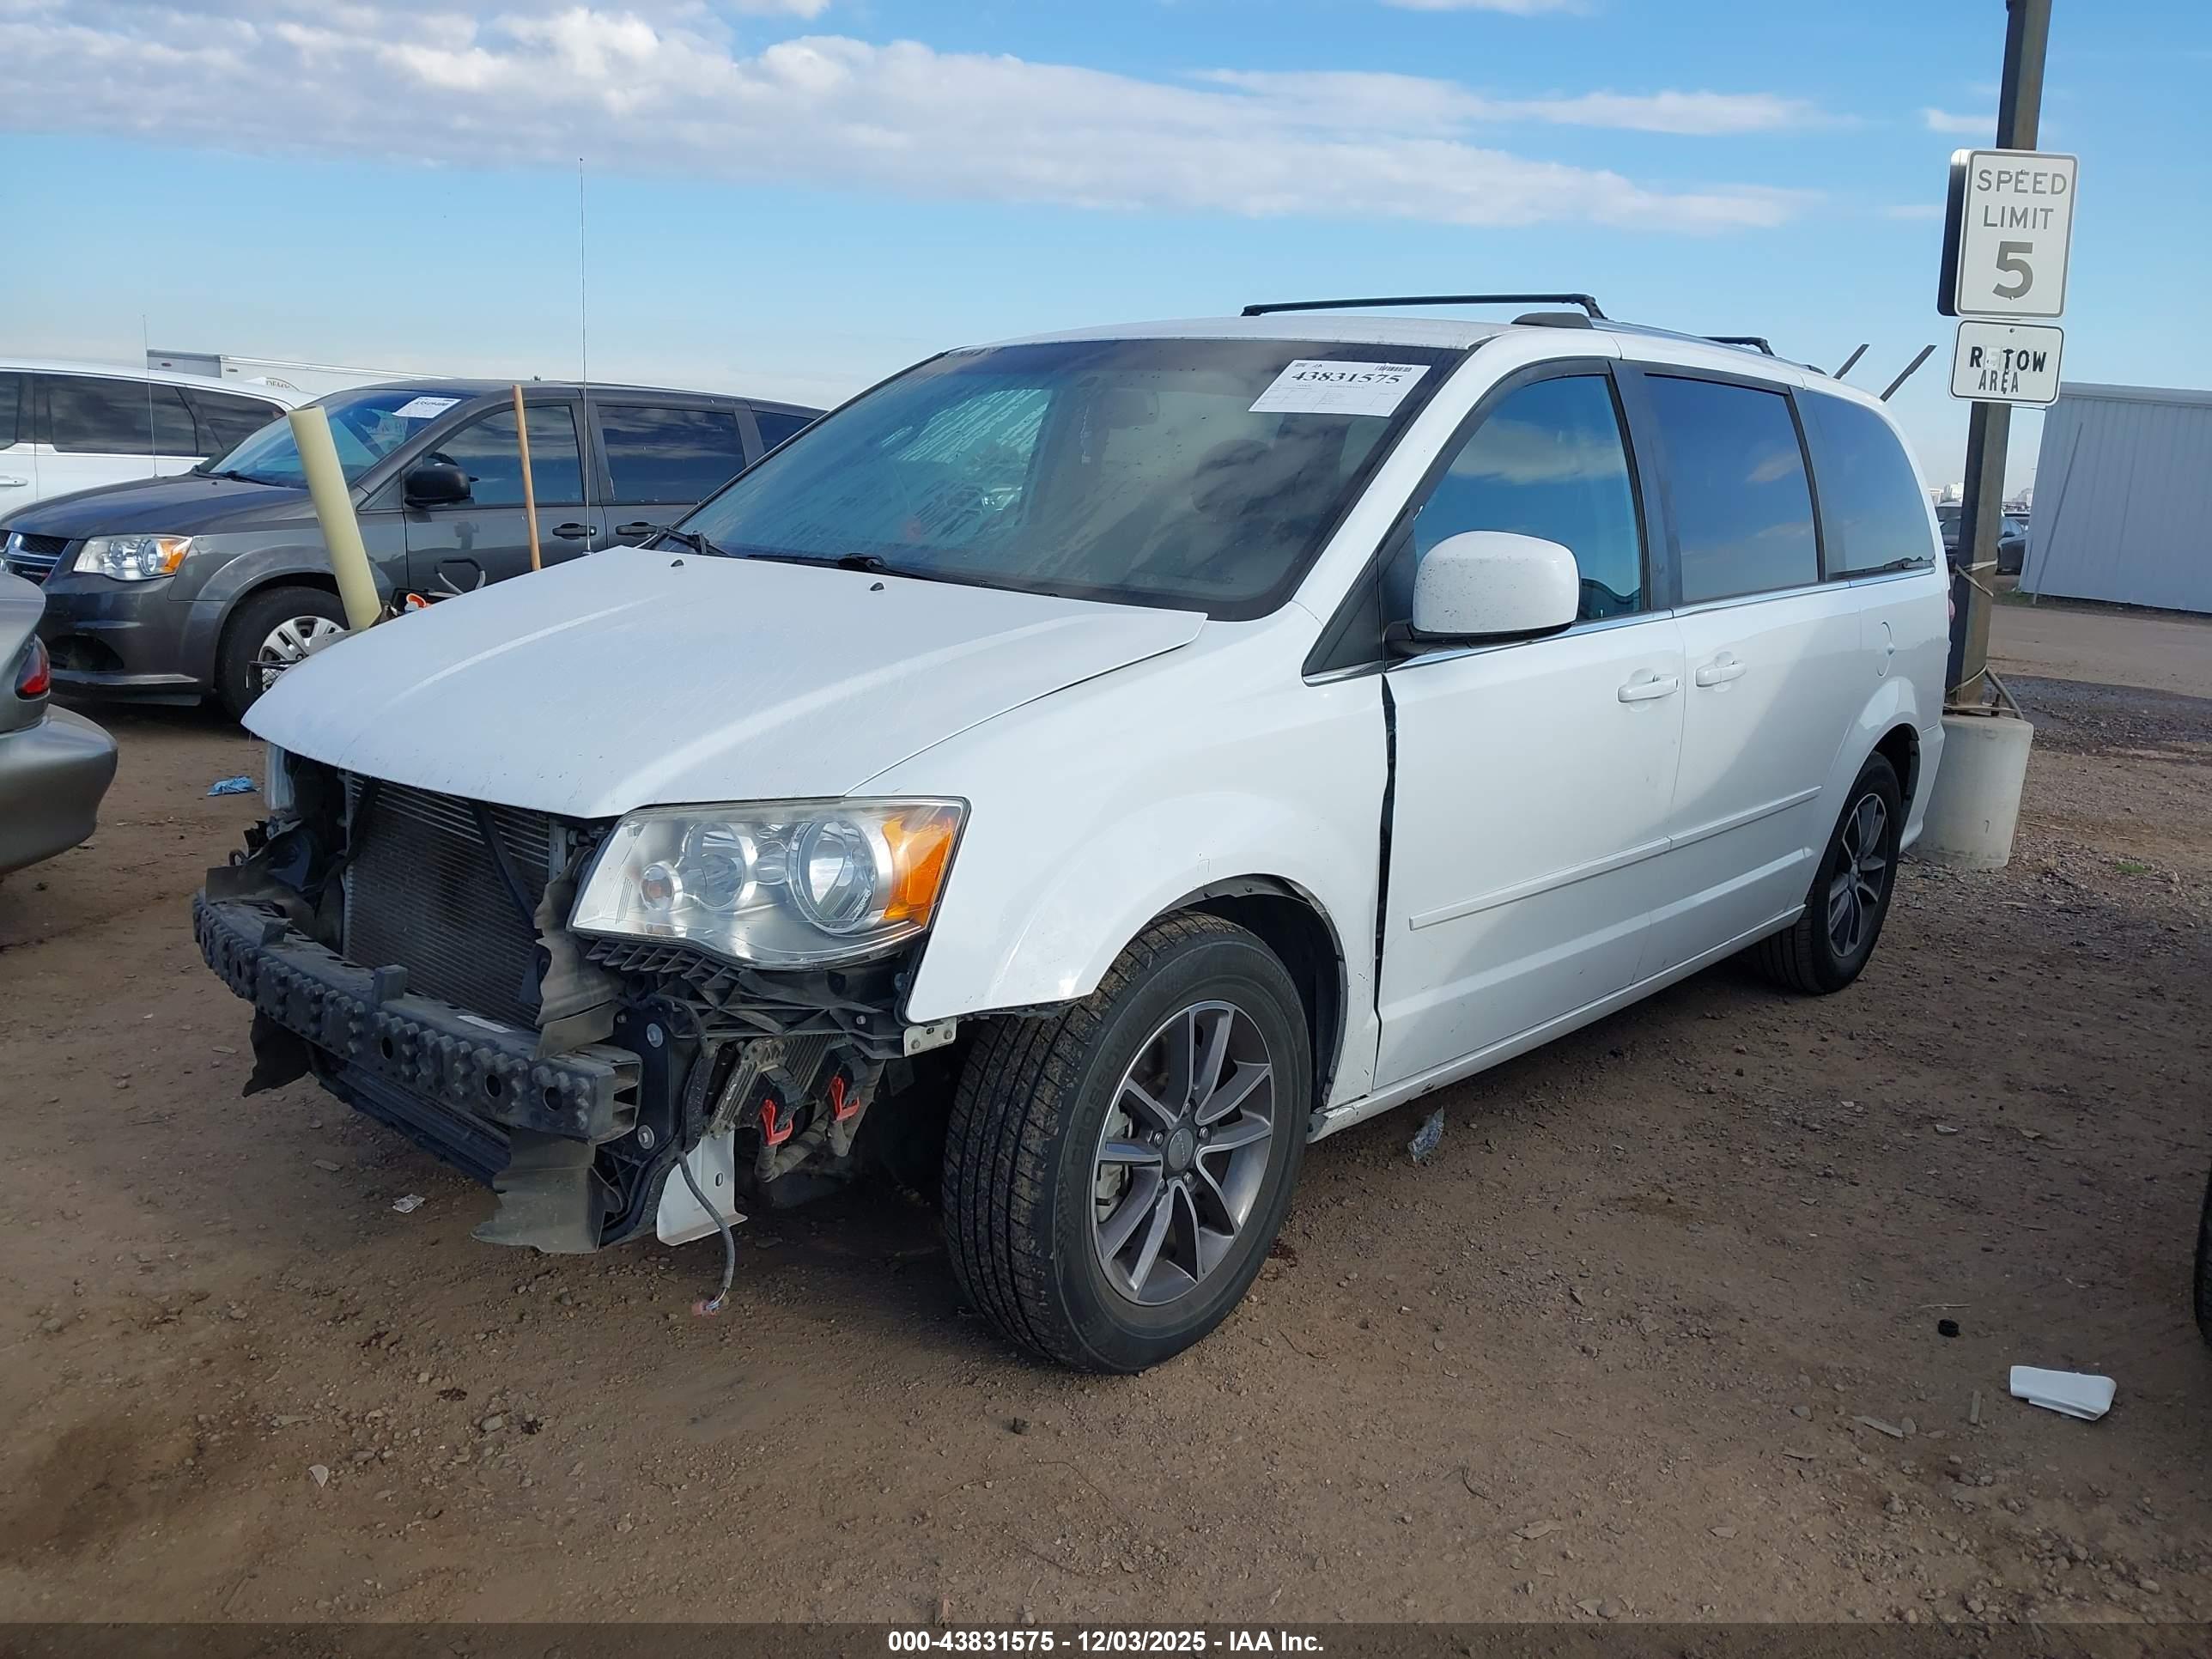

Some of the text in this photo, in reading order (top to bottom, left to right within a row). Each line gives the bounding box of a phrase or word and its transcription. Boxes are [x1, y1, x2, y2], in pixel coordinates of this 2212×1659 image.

[1976, 168, 2068, 196] SPEED
[1983, 204, 2054, 230] LIMIT
[1991, 240, 2034, 300] 5
[1291, 371, 1403, 384] 43831575
[1978, 369, 2019, 393] AREA
